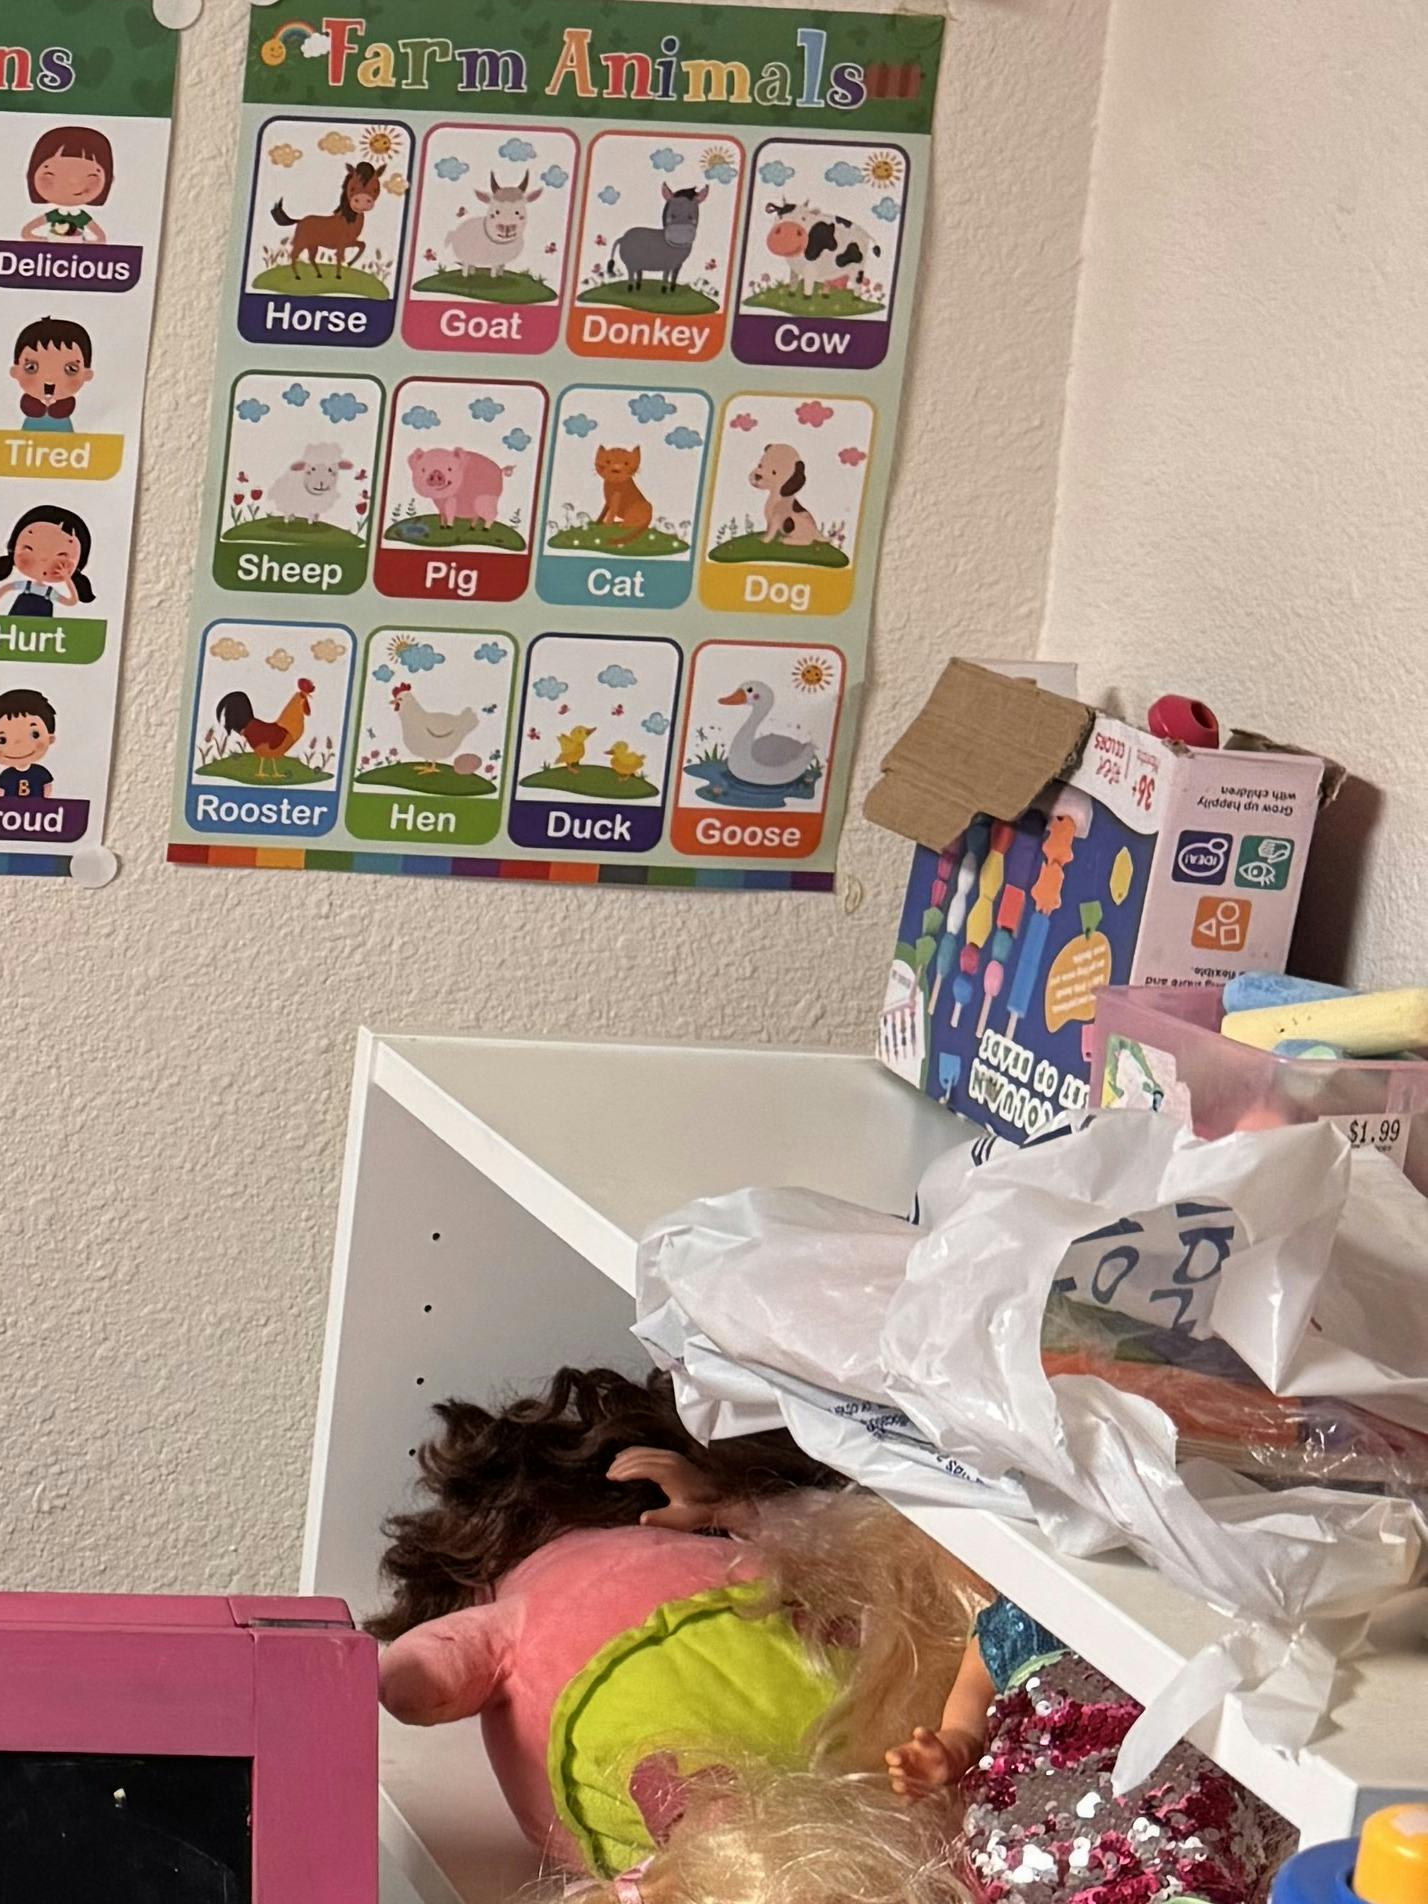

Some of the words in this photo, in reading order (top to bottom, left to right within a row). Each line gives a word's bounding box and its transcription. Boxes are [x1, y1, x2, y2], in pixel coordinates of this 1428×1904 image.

[320, 17, 527, 93] Farm
[545, 26, 868, 109] Animals
[265, 302, 367, 333] Horse
[583, 314, 709, 354] Donkey
[773, 324, 850, 355] Cow
[237, 553, 343, 590] Sheep
[743, 574, 812, 610] Dog
[196, 794, 328, 827] Rooster
[1244, 801, 1258, 811] up
[1262, 805, 1293, 816] Grow
[1272, 790, 1296, 800] with
[547, 810, 633, 842] Duck
[695, 817, 802, 848] Goose
[1185, 854, 1218, 866] IDEA!
[1348, 1120, 1401, 1143] $1.99
